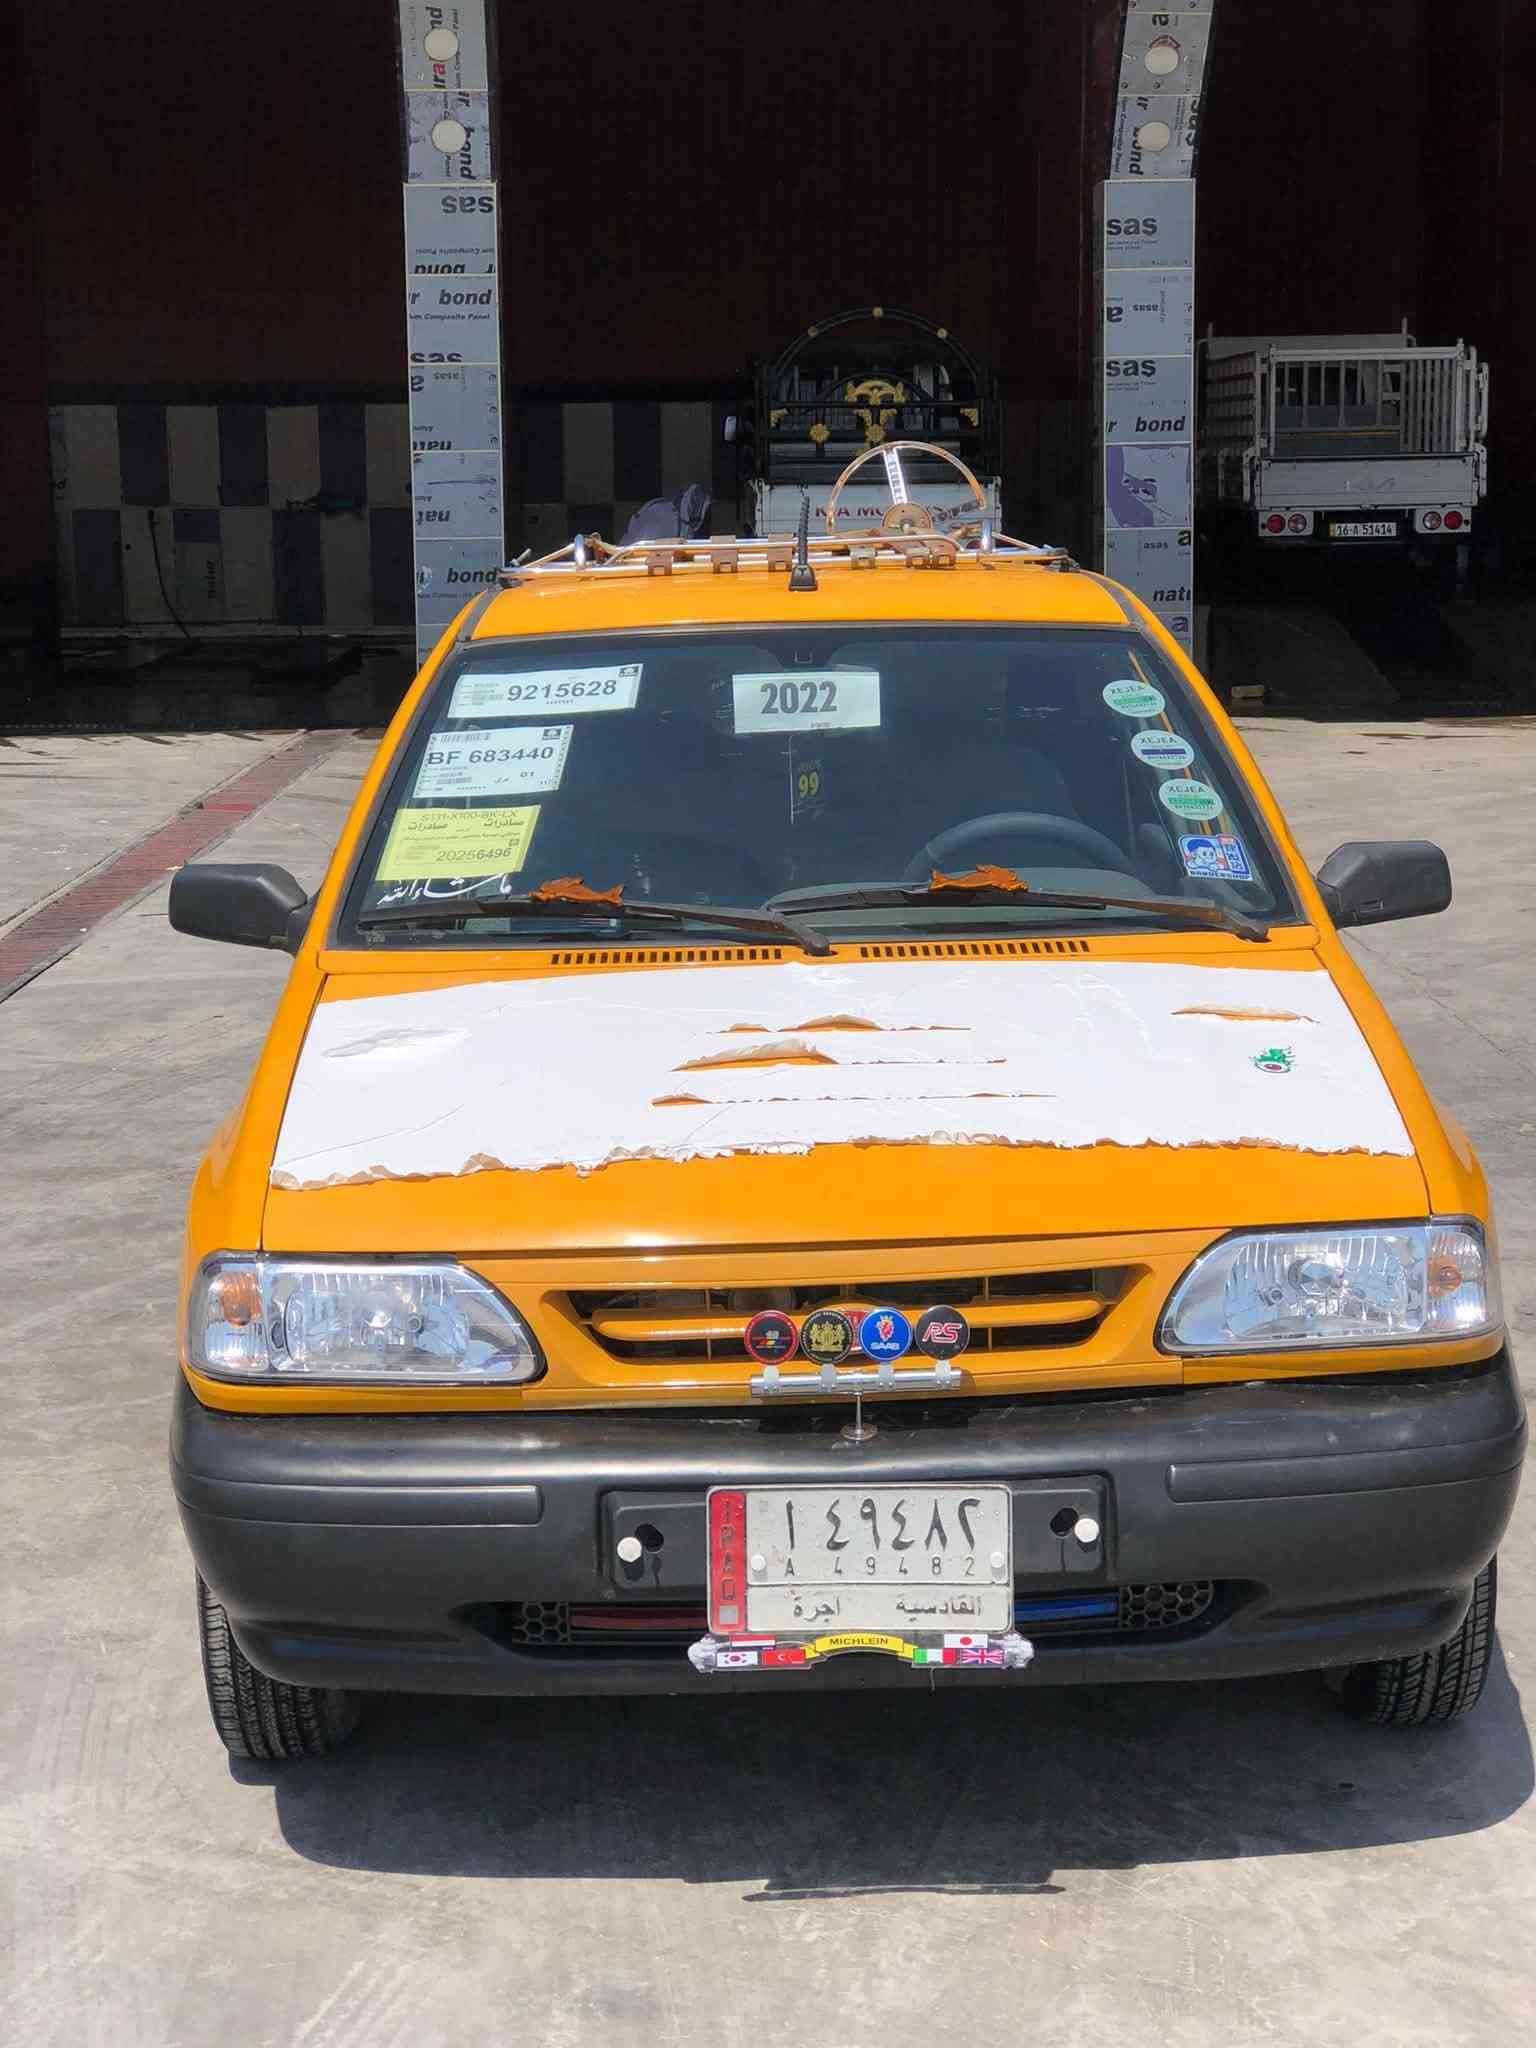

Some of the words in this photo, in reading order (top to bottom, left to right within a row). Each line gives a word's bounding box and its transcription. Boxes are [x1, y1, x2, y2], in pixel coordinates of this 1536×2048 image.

[1106, 217, 1158, 236] sas
[439, 288, 492, 305] bond
[1106, 359, 1157, 377] sas
[1135, 415, 1186, 433] bond
[447, 567, 498, 583] bond
[507, 679, 617, 701] 9215628
[760, 681, 838, 714] 2022
[428, 750, 462, 765] BF
[468, 746, 554, 764] 683440
[828, 1636, 890, 1647] MICHLEIN
